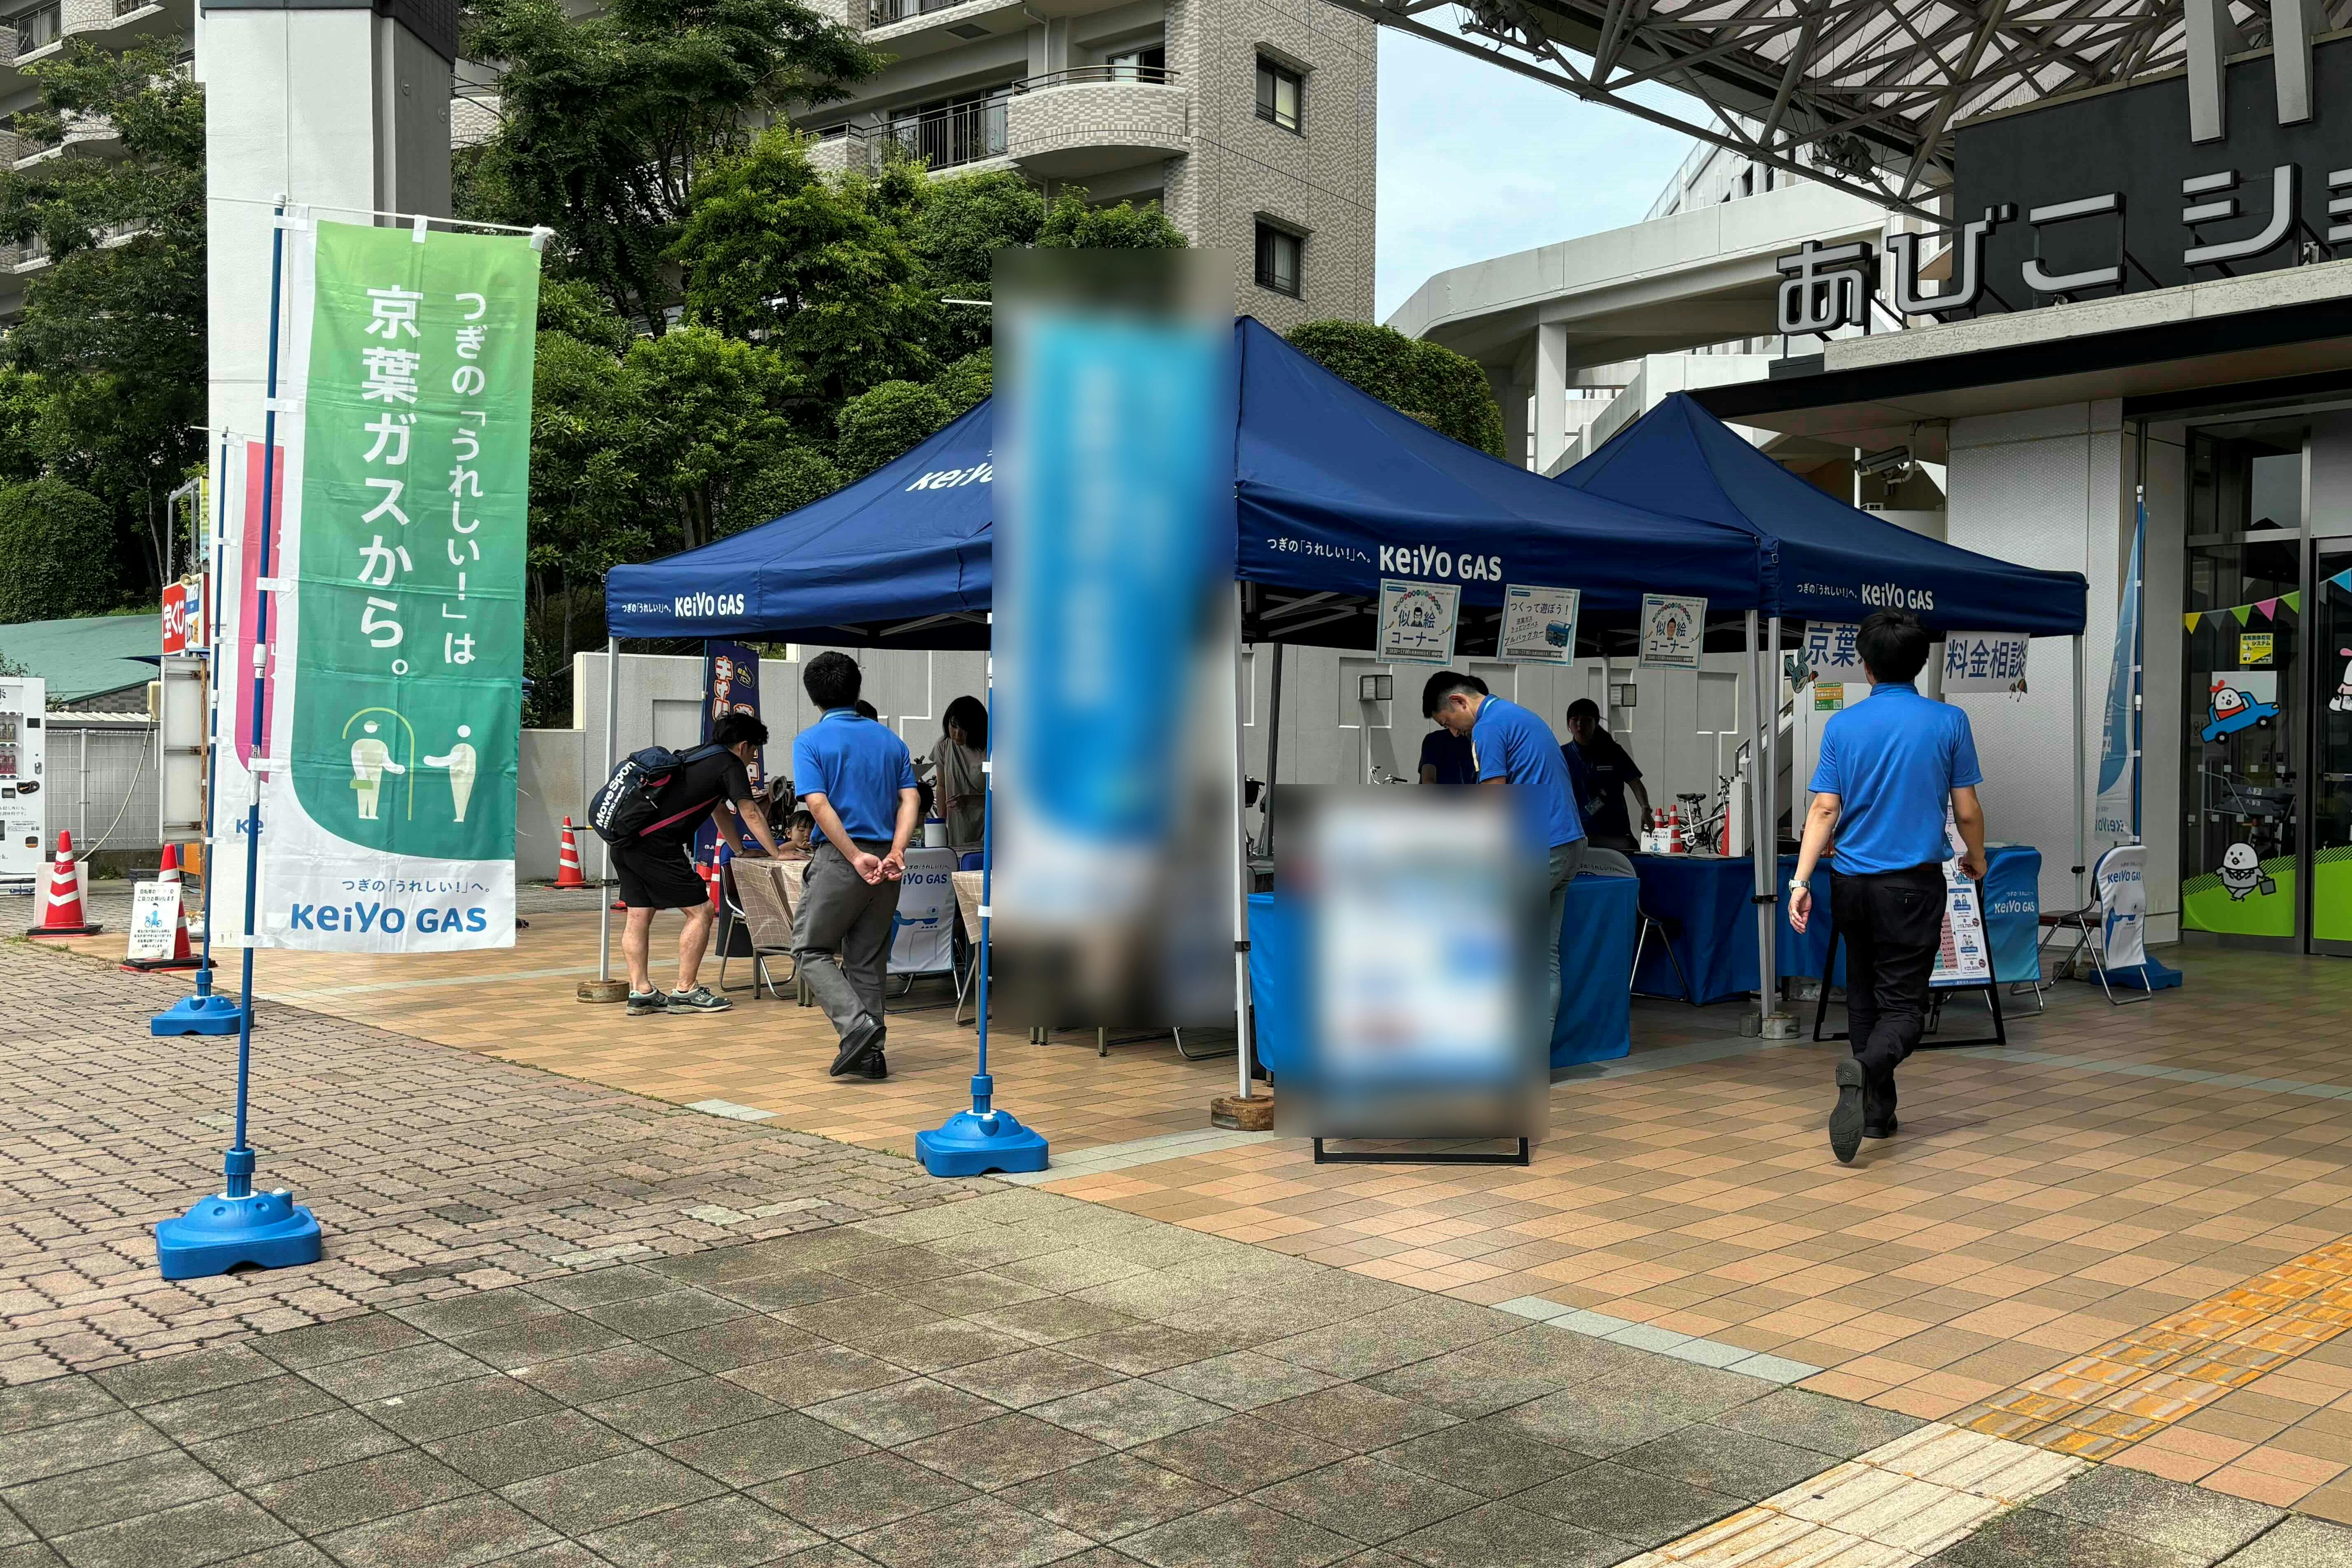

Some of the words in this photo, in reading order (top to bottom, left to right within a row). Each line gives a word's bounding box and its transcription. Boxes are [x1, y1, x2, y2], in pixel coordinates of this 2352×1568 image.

[357, 285, 423, 675] 京葉ガスから。
[443, 292, 488, 665] つぎの「うれしい！」は
[1267, 537, 1371, 563] つぎの「うれしい!」へ。
[1458, 554, 1502, 581] GAS
[718, 593, 744, 616] GAS
[1510, 601, 1568, 615] つくって遊ぼう！
[1908, 589, 1934, 610] GAS
[163, 600, 184, 639] 宝くじ
[1391, 631, 1439, 647] コーナー
[1650, 640, 1689, 653] コーナー
[1805, 623, 1862, 667] 京葉
[1946, 639, 2028, 679] 料金相談
[342, 877, 490, 894] つぎの「うれしい!」へ。
[926, 874, 947, 884] GAS
[2131, 870, 2141, 882] GAS
[2022, 901, 2035, 912] GAS
[416, 907, 487, 934] GAS
